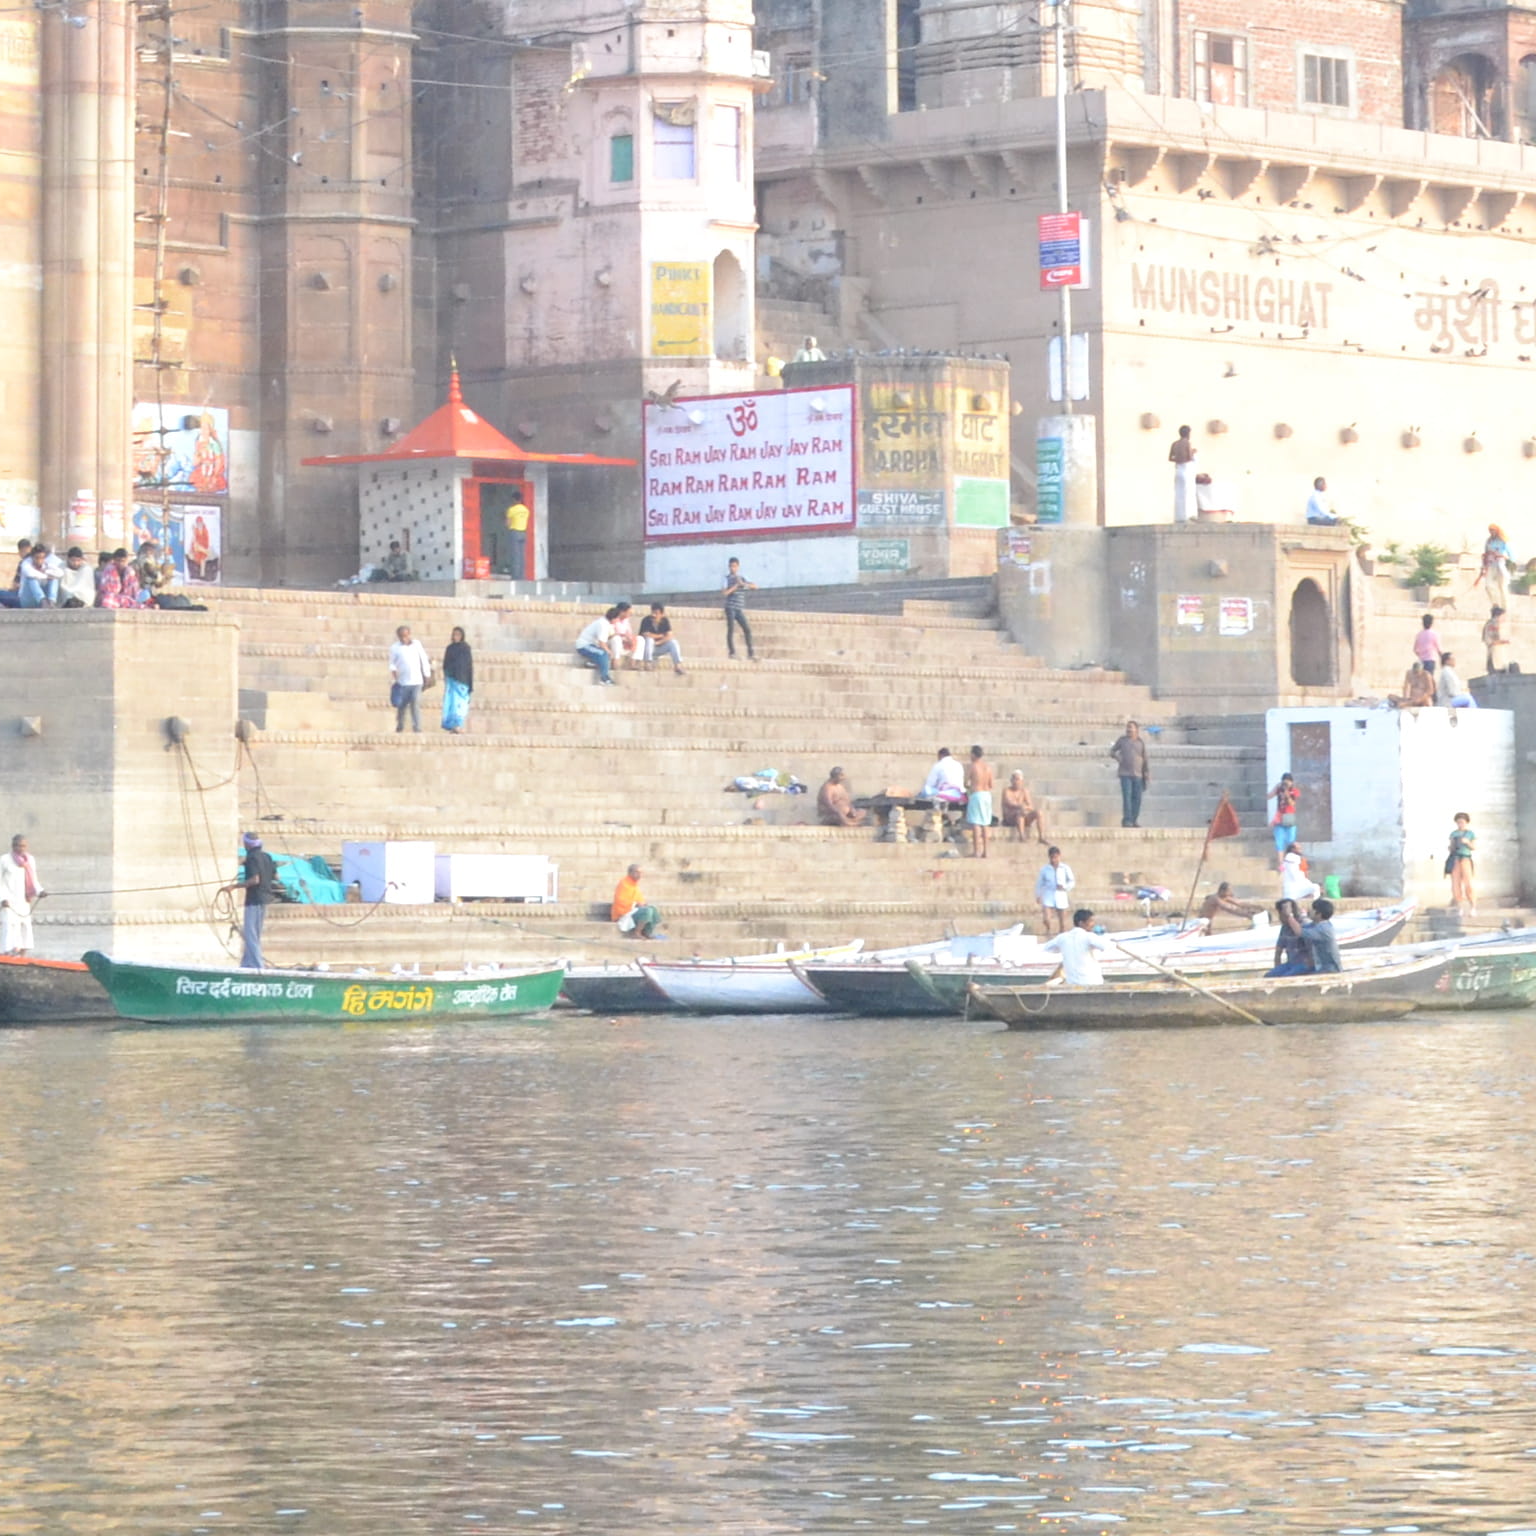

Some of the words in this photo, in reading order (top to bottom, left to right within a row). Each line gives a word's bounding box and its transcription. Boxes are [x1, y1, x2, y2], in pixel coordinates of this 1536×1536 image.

[1132, 262, 1249, 321] MUNSHI
[1253, 276, 1333, 328] GHAT
[650, 450, 671, 467] SRI
[675, 448, 701, 465] RAM
[704, 445, 726, 464] JAY
[730, 443, 757, 461] RAM
[760, 441, 783, 459] JAY
[786, 438, 808, 455] JAY
[812, 437, 843, 454] RAM
[650, 478, 682, 496] RAM
[686, 476, 714, 494] RAM
[718, 474, 748, 492] RAM
[753, 471, 786, 489] RAM
[797, 467, 837, 485] RAM
[859, 503, 897, 514] GUEST
[900, 503, 942, 515] HOUSE
[871, 492, 918, 504] SHIVA
[648, 509, 668, 527] SRI
[673, 507, 700, 525] RAM
[706, 506, 726, 524] JAY
[729, 504, 752, 521] RAM
[756, 502, 777, 519] JAY
[782, 504, 803, 518] JAY
[808, 499, 844, 516] RAM
[209, 976, 232, 999] दर्द
